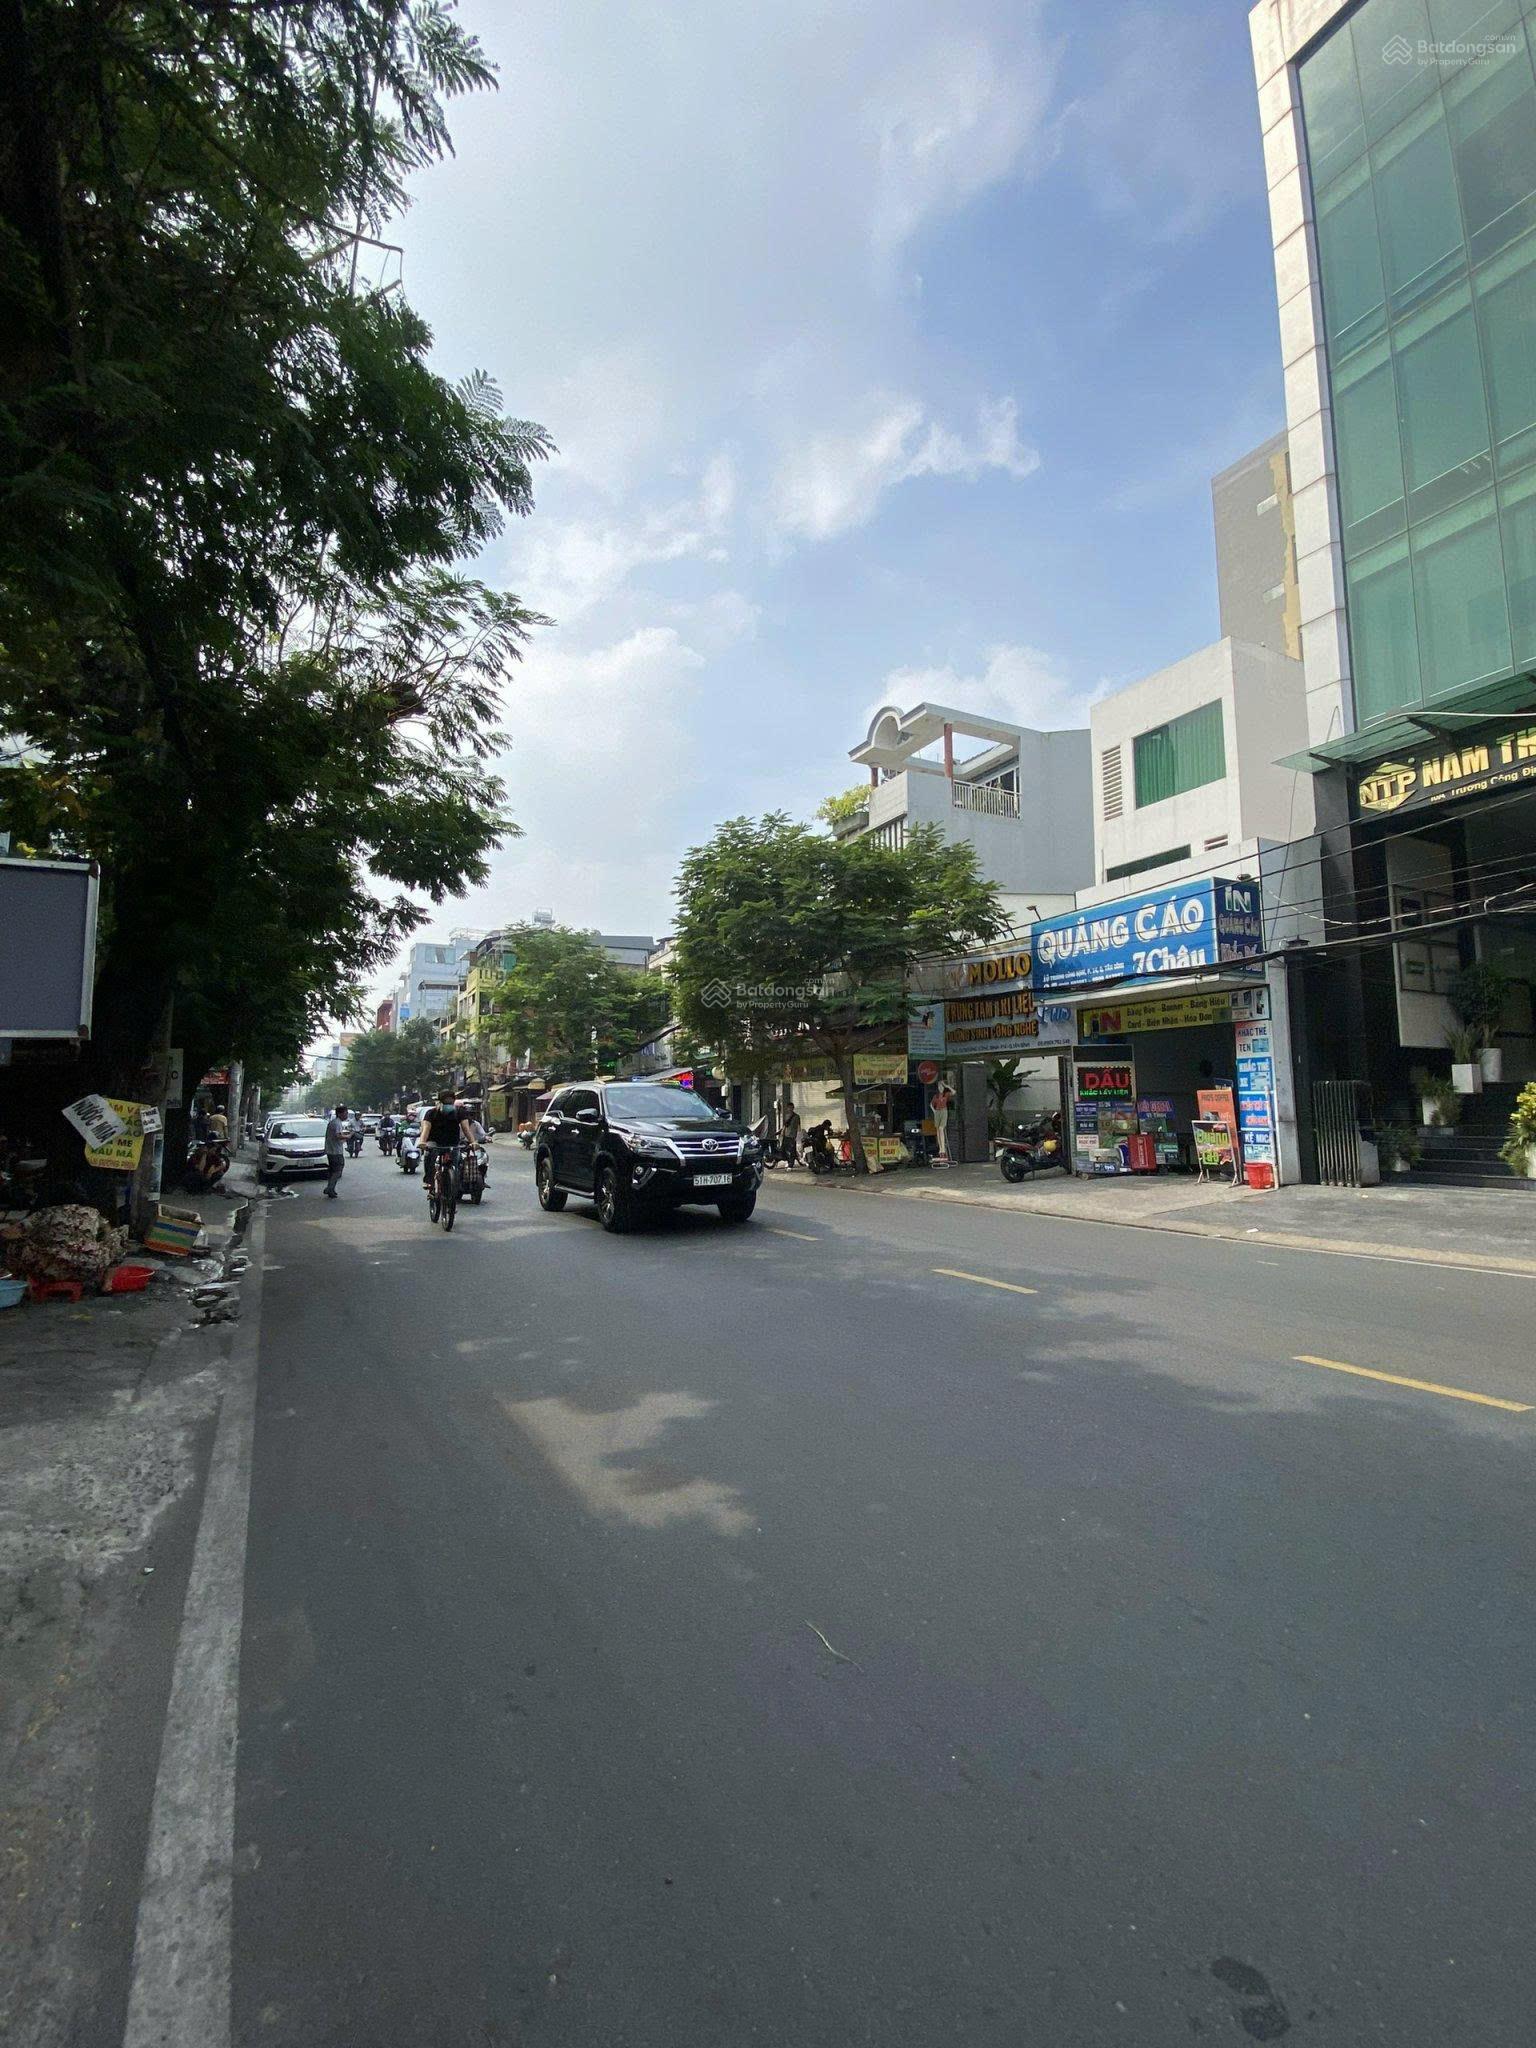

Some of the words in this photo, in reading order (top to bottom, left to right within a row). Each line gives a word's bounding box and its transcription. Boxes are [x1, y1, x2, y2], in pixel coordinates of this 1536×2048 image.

[1422, 745, 1490, 788] NAM
[1359, 769, 1417, 806] NTP
[1037, 916, 1130, 968] QUẢNG
[1134, 896, 1205, 943] CÁO
[968, 953, 1032, 985] MOLLO
